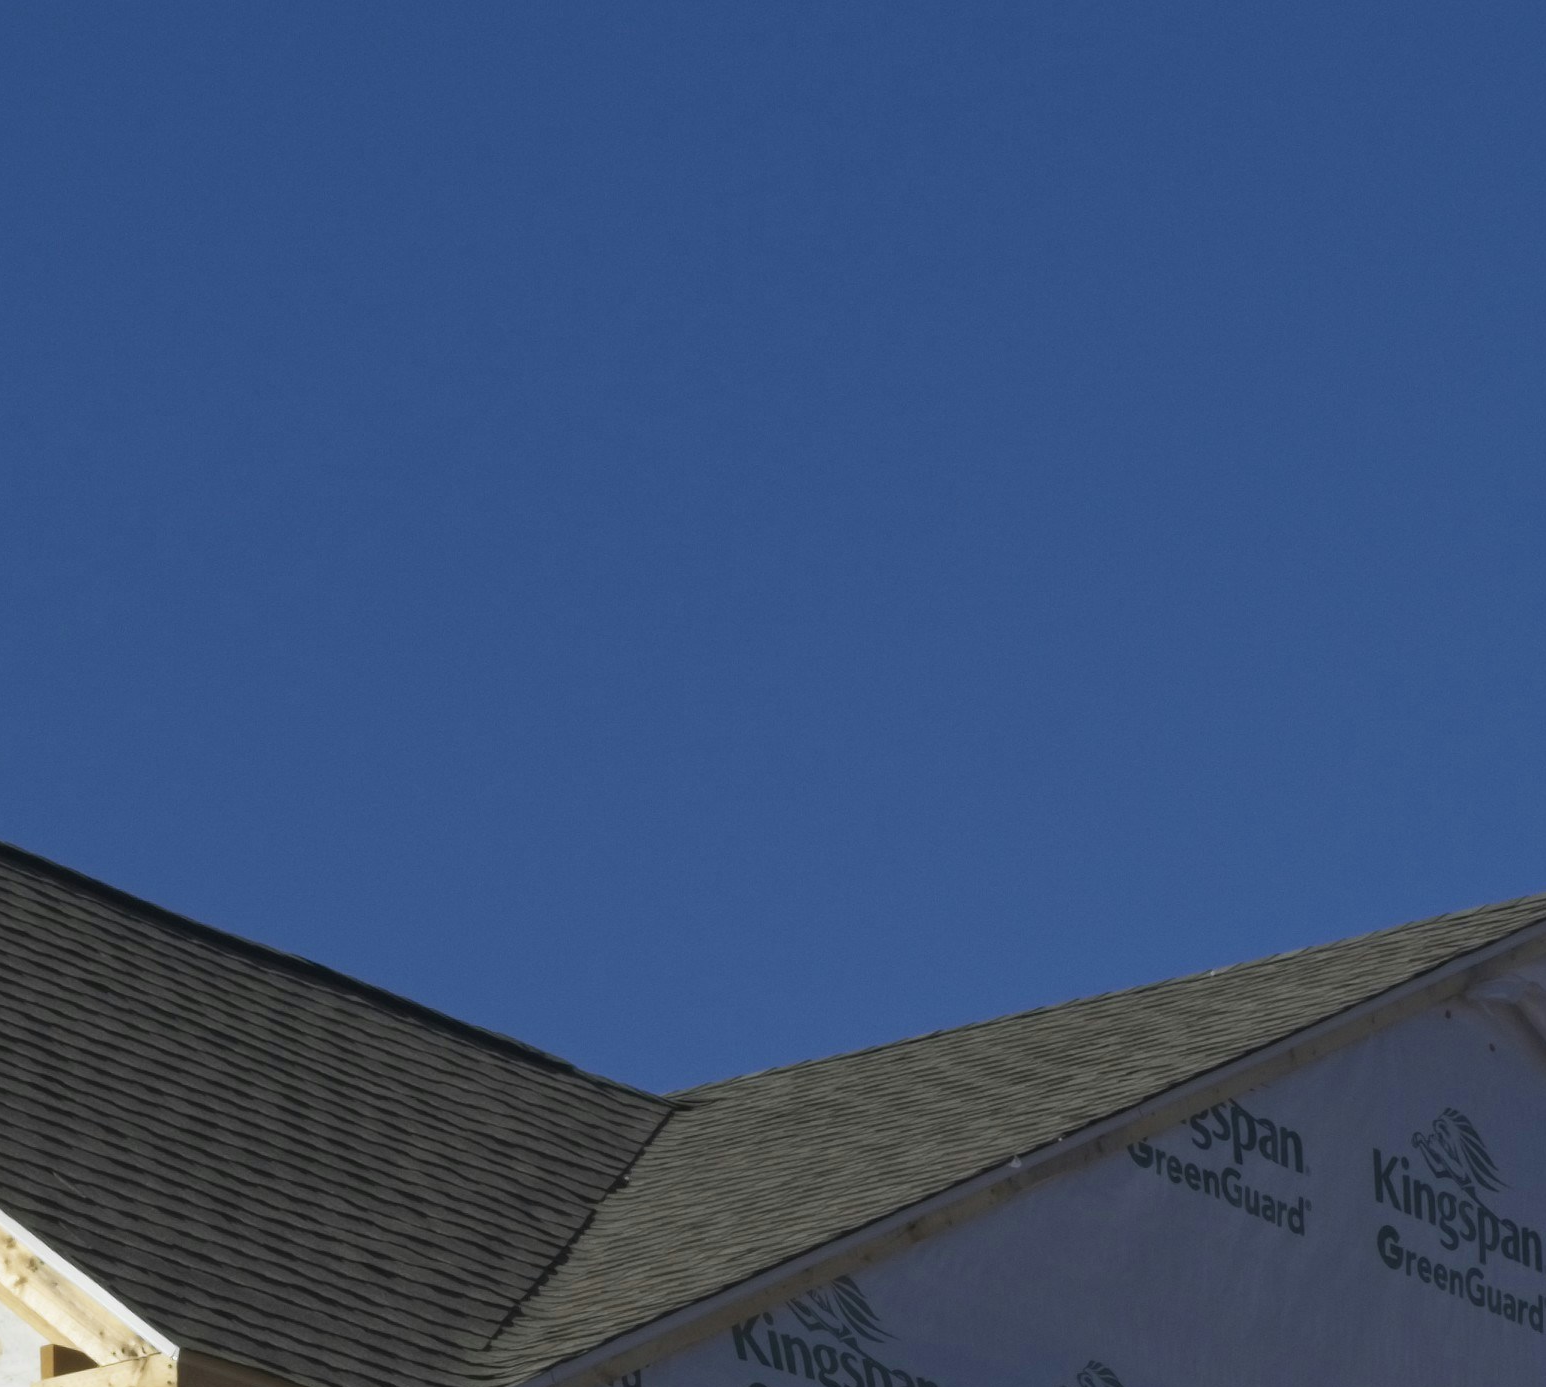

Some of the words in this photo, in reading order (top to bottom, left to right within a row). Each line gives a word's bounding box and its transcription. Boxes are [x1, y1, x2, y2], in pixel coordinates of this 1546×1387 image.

[1125, 1139, 1305, 1236] GreenGuard
[1372, 1147, 1546, 1274] Kingspan
[1376, 1224, 1546, 1334] GreenGuard
